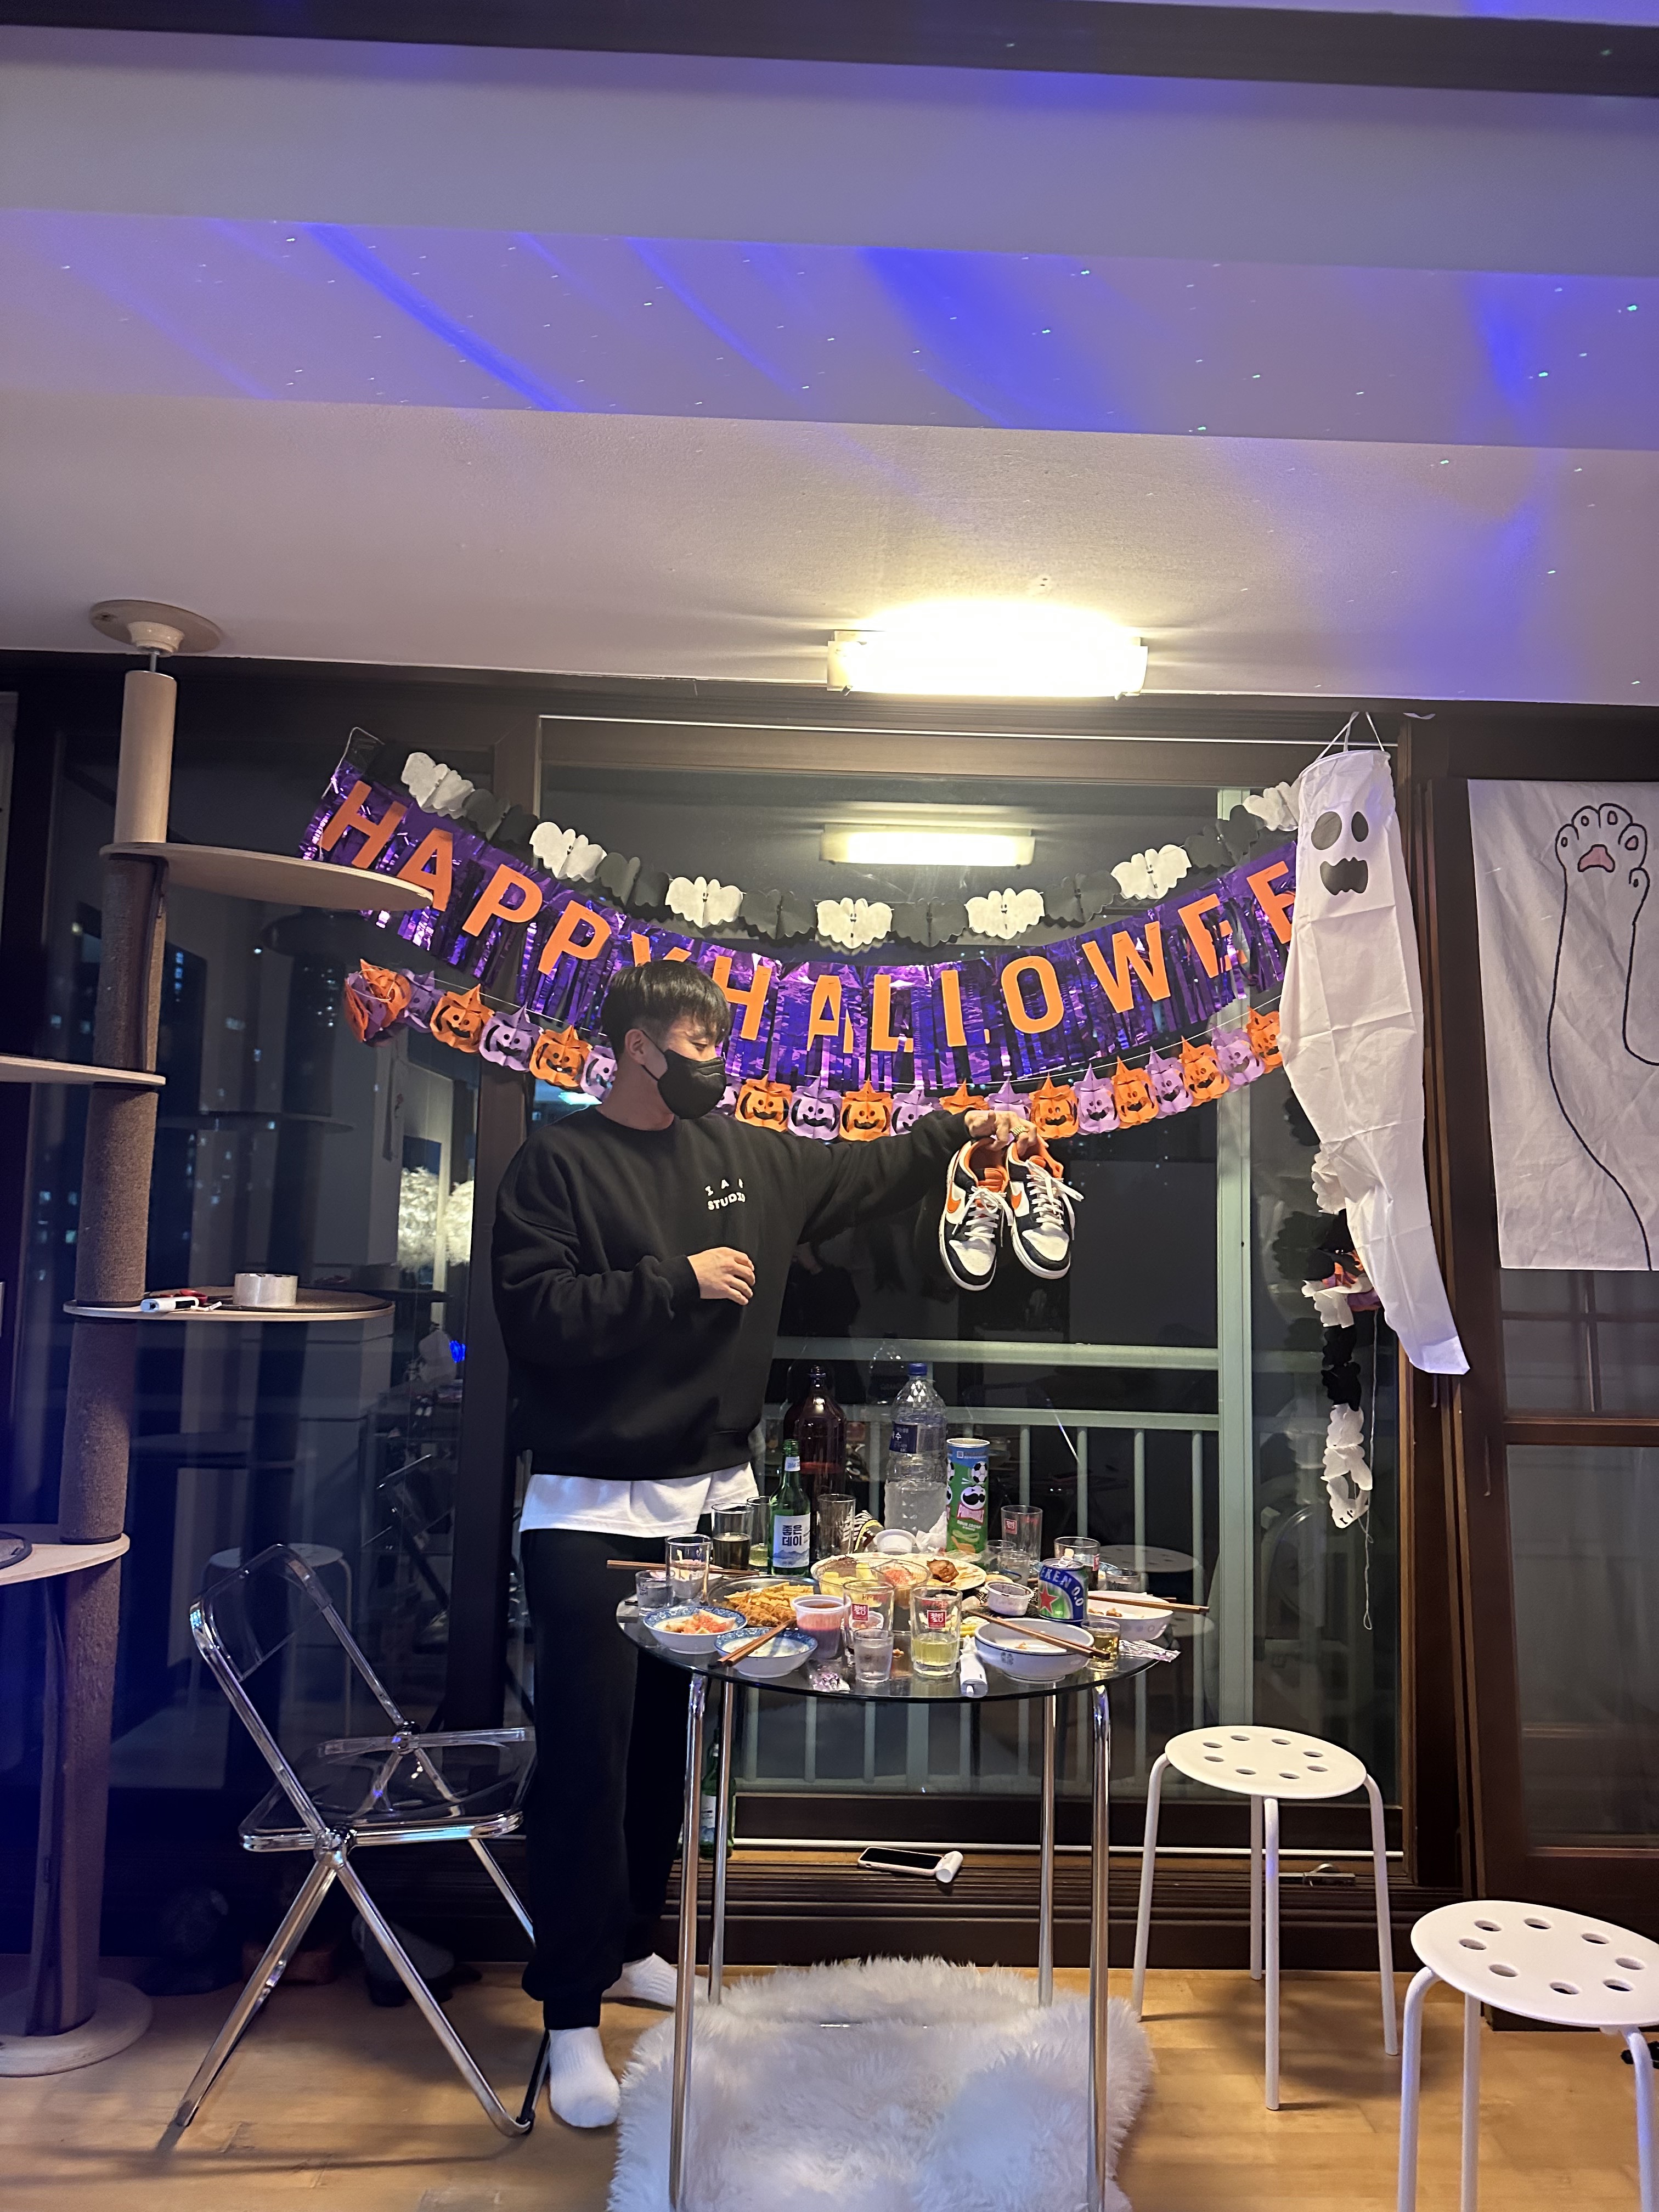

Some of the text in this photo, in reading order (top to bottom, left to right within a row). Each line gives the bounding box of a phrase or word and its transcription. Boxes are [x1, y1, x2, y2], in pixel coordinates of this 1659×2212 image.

[782, 1525, 802, 1536] 좋은
[782, 1536, 802, 1546] 데이
[1071, 1586, 1084, 1606] 0.0
